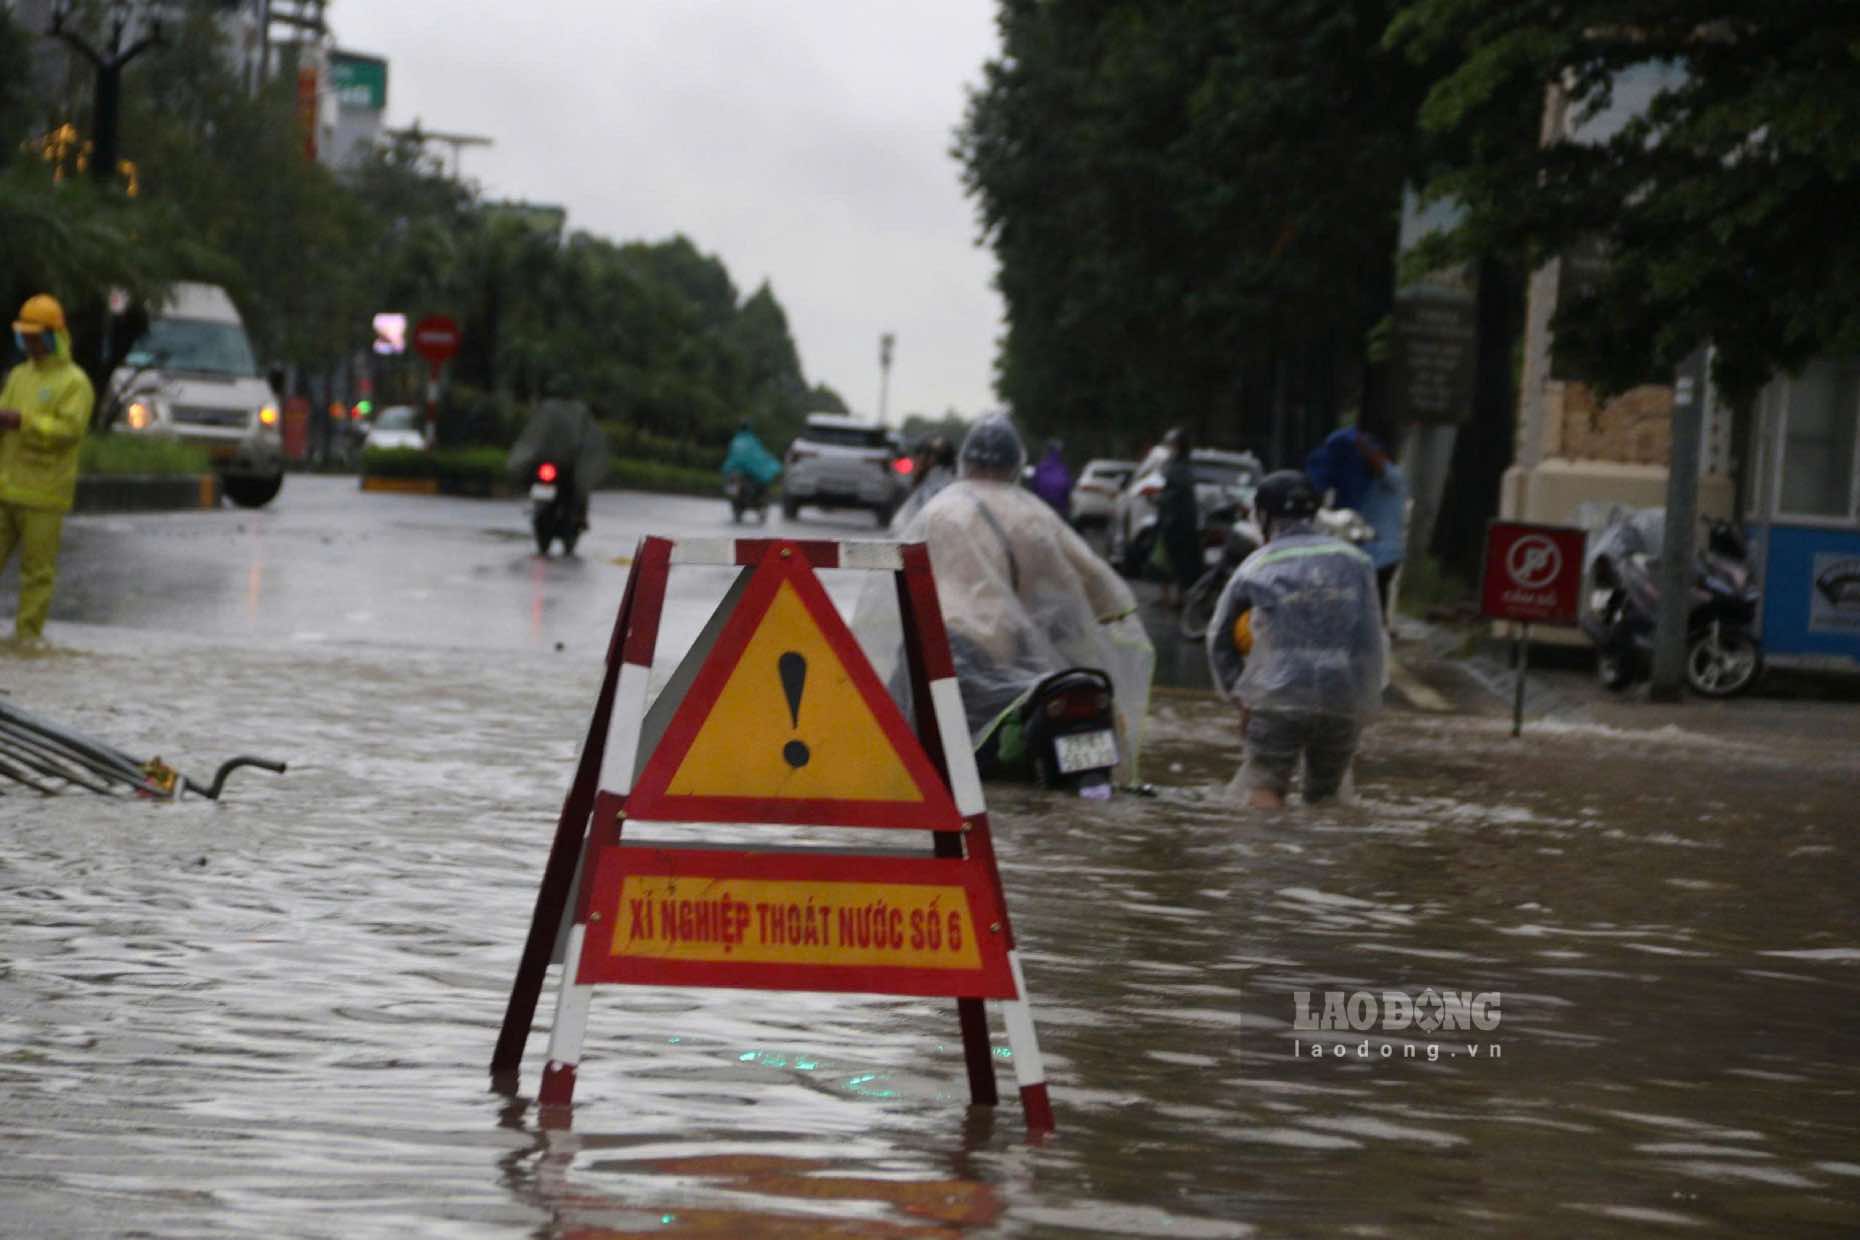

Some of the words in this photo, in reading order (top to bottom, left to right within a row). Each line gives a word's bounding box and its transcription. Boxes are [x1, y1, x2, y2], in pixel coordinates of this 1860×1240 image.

[661, 892, 750, 954] NGHIỆP
[756, 896, 832, 947] THOÁT
[839, 899, 903, 950] NƯỚC
[911, 895, 942, 951] SỐ
[948, 911, 962, 952] 6
